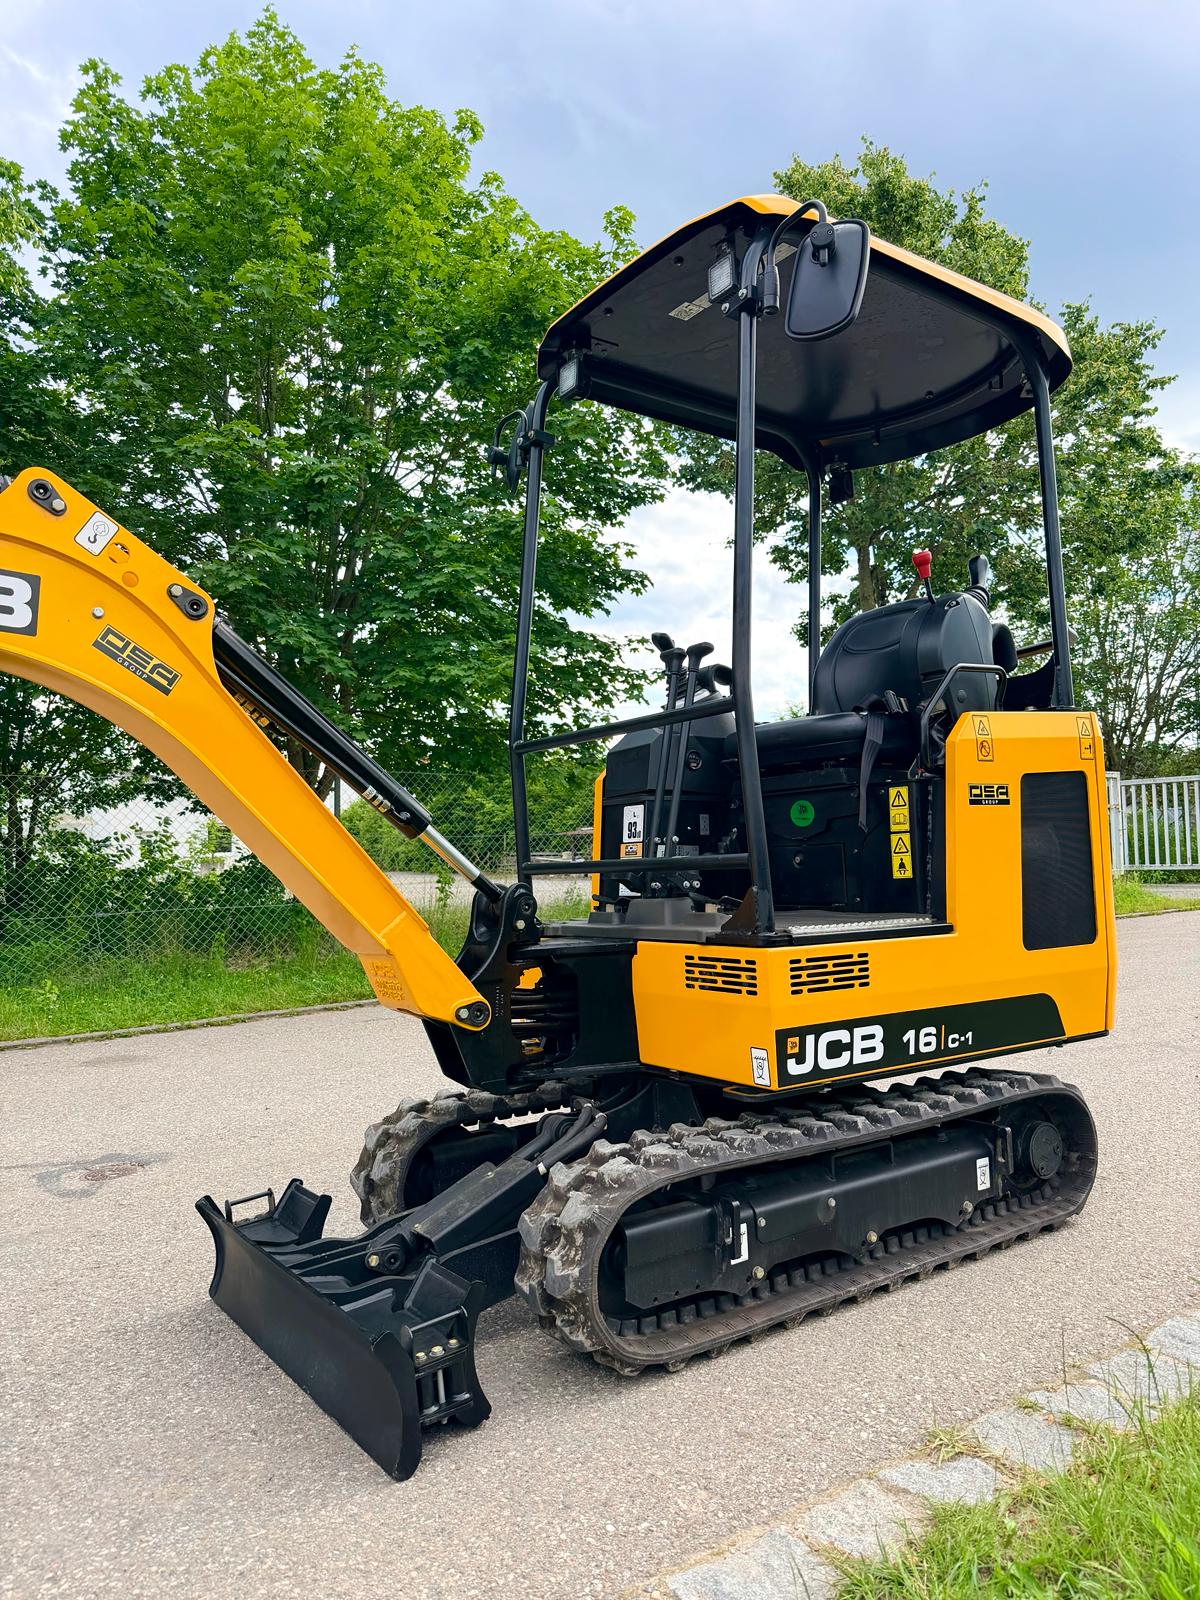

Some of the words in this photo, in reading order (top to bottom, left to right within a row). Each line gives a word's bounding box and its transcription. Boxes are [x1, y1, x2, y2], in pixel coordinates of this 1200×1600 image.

[117, 657, 148, 679] GROUP
[628, 821, 638, 839] 93
[786, 1024, 884, 1076] JCB
[901, 1026, 937, 1055] 16
